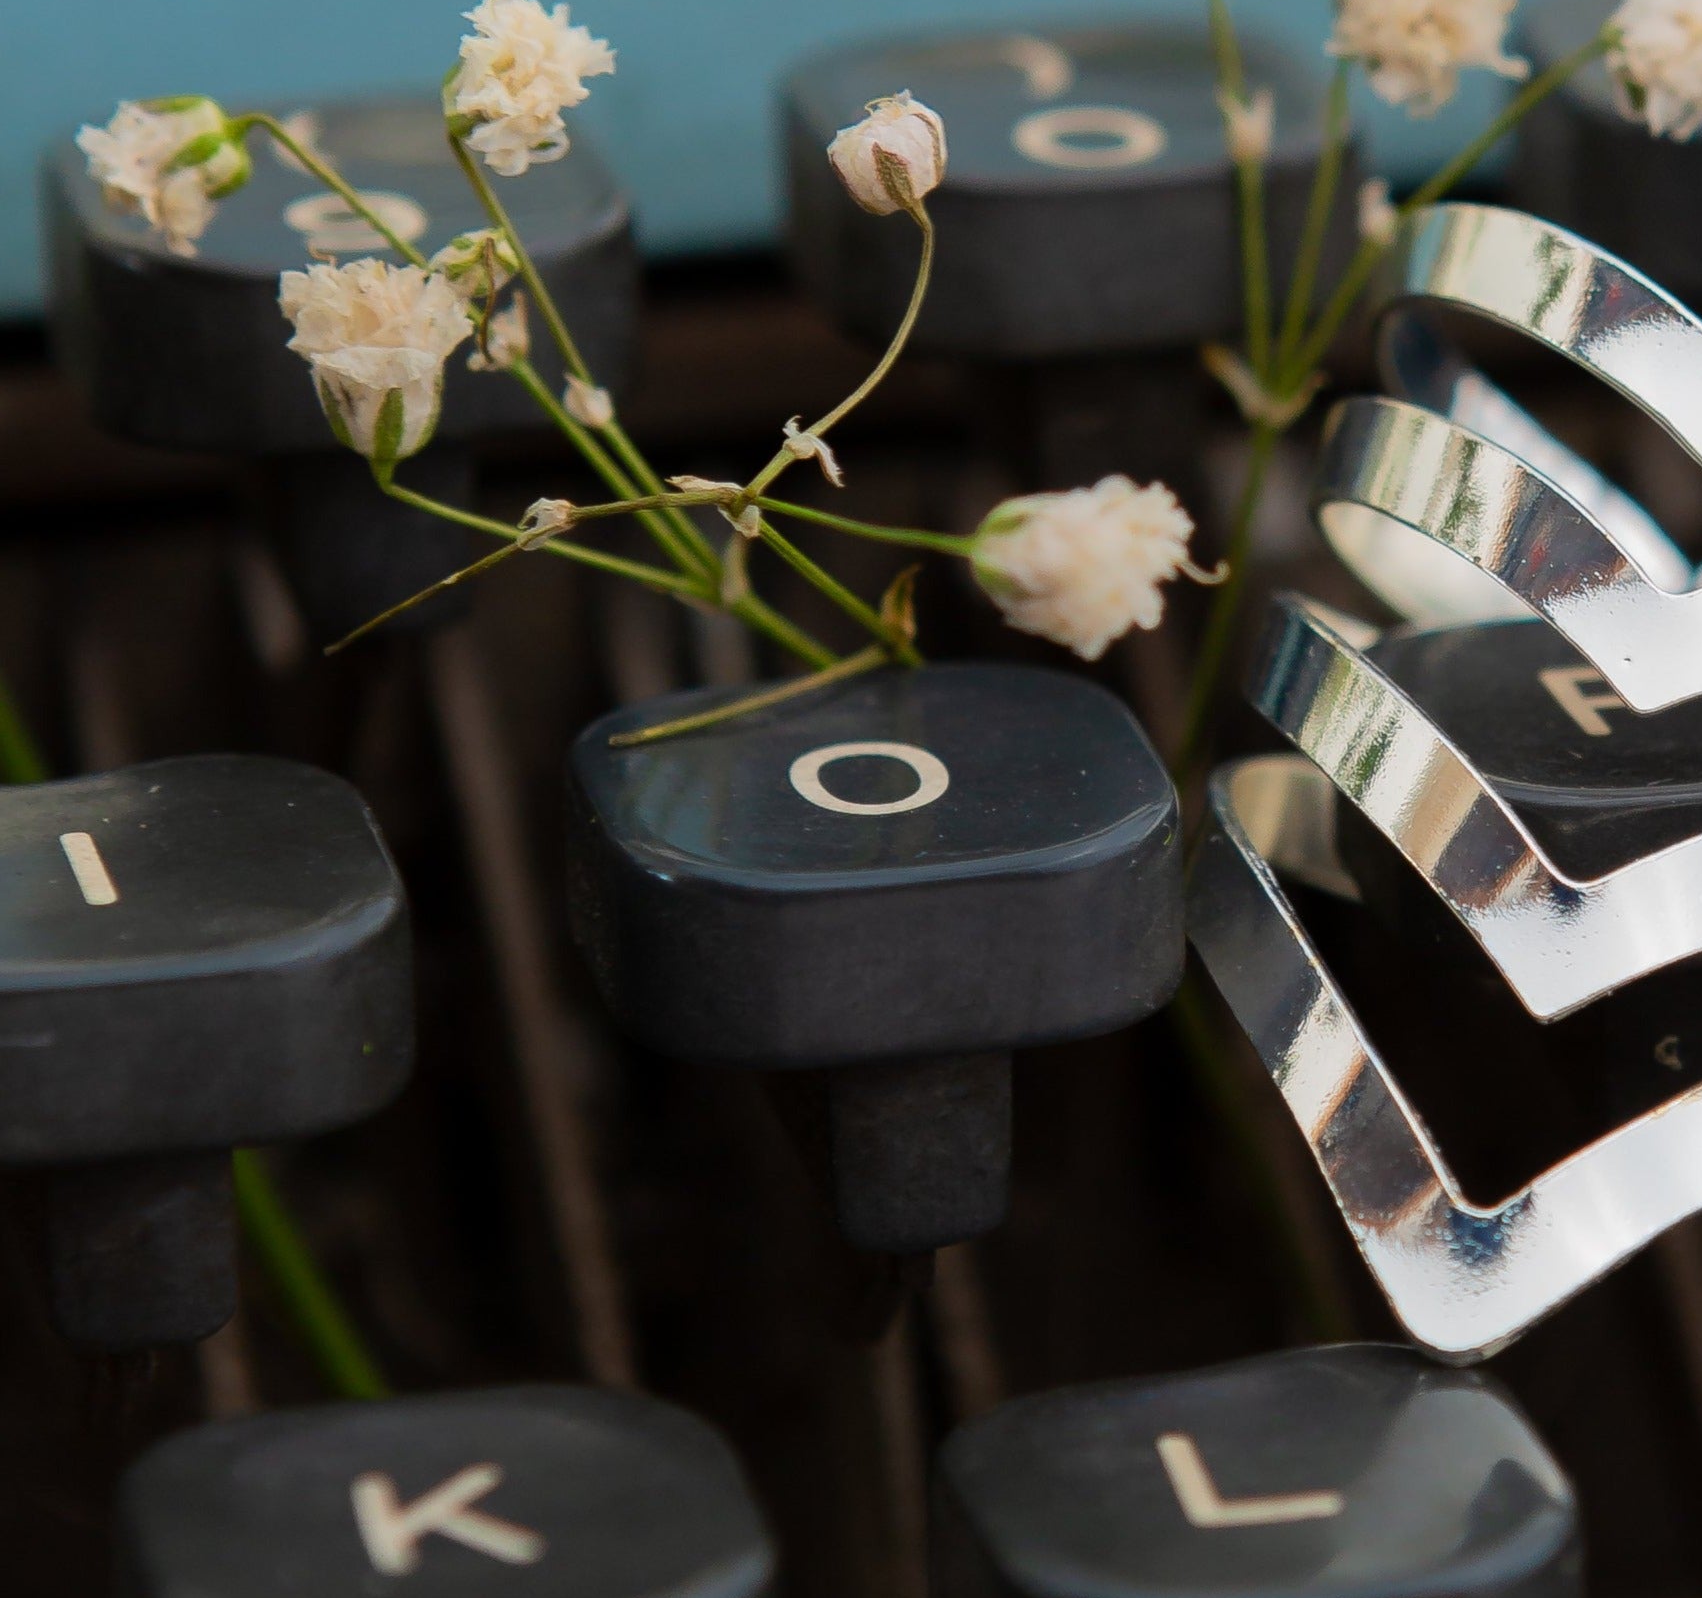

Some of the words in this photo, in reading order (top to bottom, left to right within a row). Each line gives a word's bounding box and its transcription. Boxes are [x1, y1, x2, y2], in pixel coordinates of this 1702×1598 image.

[790, 741, 950, 815] O
[59, 832, 119, 906] I
[350, 1462, 545, 1576] K
[1157, 1432, 1345, 1529] L
